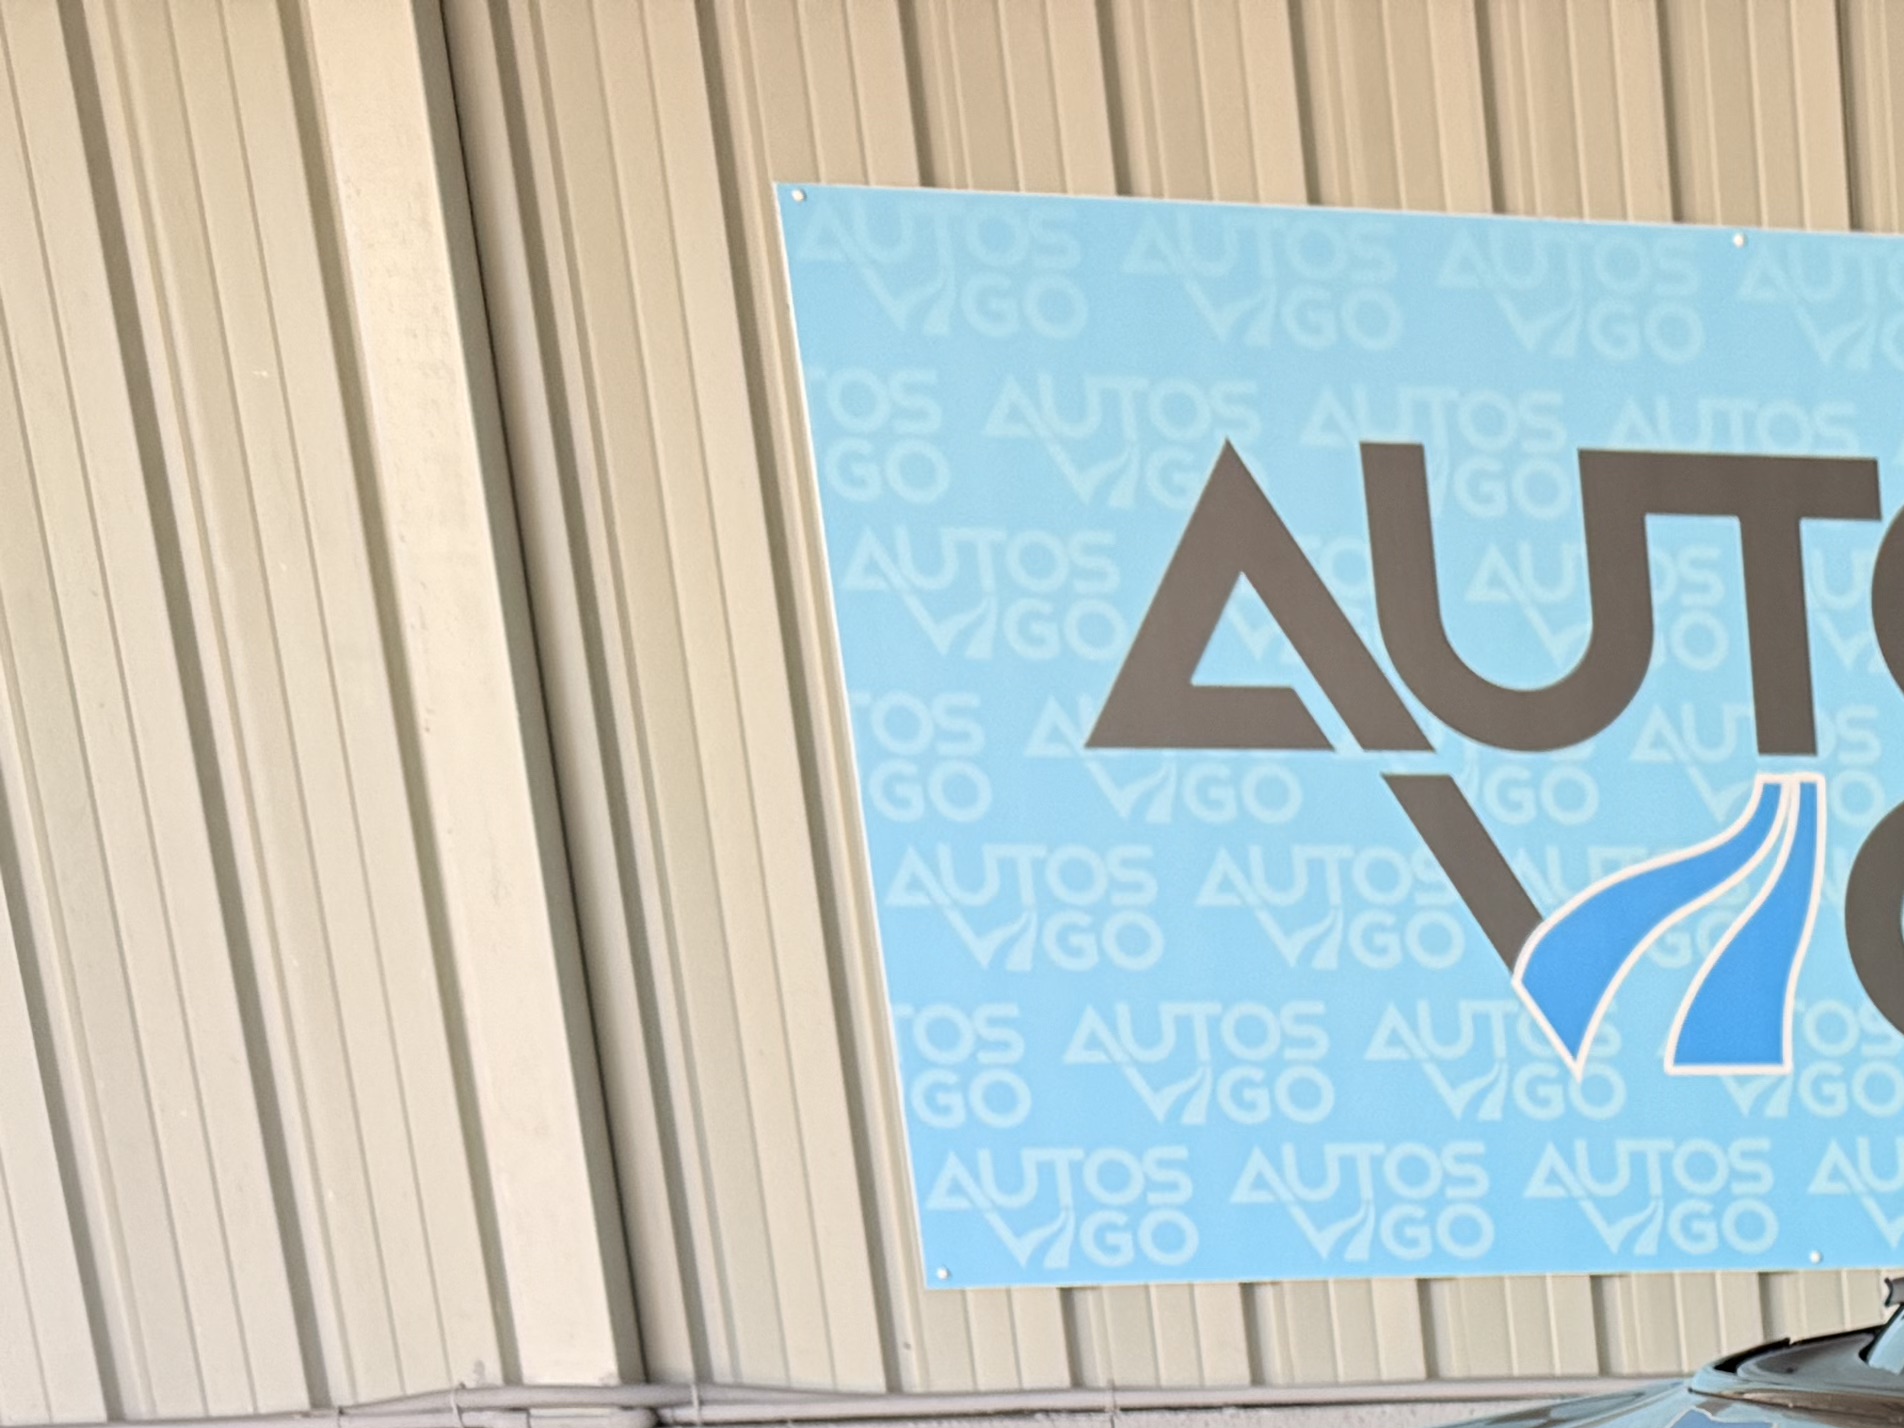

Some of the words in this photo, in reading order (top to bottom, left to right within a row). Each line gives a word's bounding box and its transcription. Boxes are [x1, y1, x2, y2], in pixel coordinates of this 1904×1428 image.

[804, 206, 1082, 273] AUTOS
[1120, 213, 1398, 283] AUTOS
[1435, 226, 1699, 297] AUTOS
[981, 370, 1262, 444] AUTOS
[840, 523, 1121, 594] AUTOS
[885, 841, 1158, 907] AUTOS
[1062, 1000, 1331, 1064] AUTOS
[926, 1144, 1193, 1211] AUTOS
[1229, 1141, 1492, 1204] AUTOS
[1523, 1137, 1775, 1199] AUTOS
